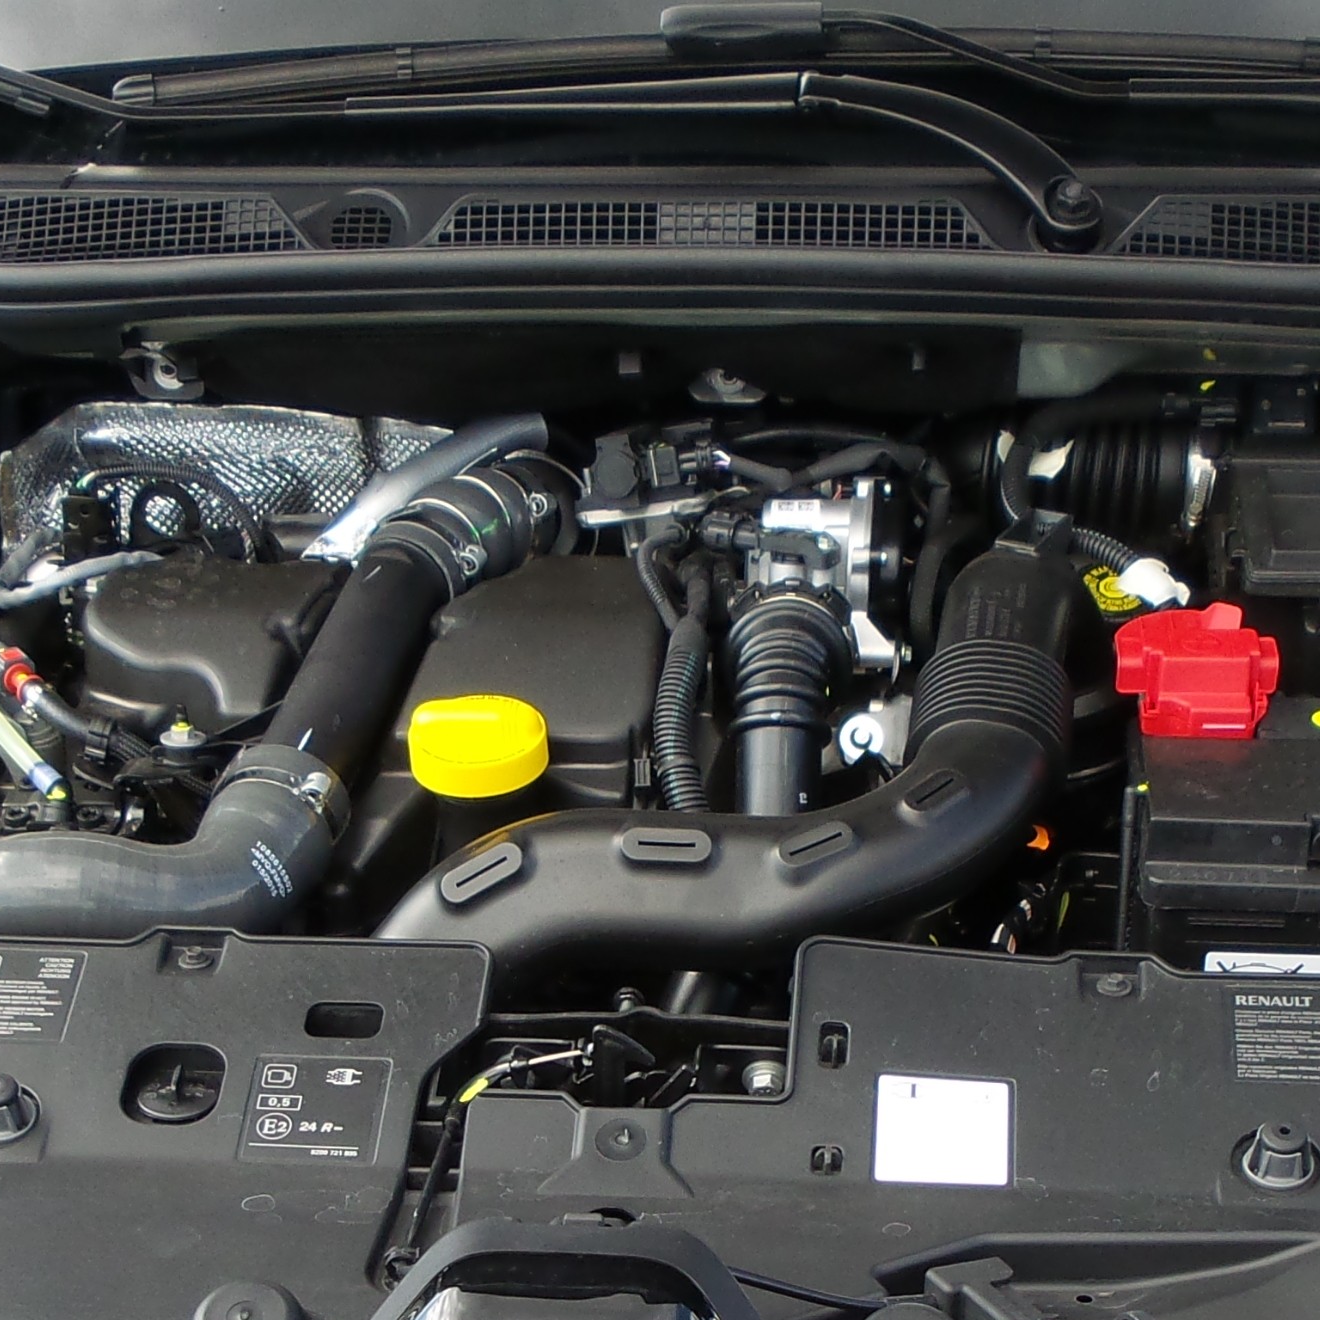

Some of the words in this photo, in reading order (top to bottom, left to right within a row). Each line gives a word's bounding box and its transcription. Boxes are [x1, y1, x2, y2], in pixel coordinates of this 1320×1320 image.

[1235, 994, 1313, 1008] RENAULT
[268, 1097, 291, 1108] 0,5
[262, 1119, 288, 1135] E2
[299, 1122, 317, 1132] 24
